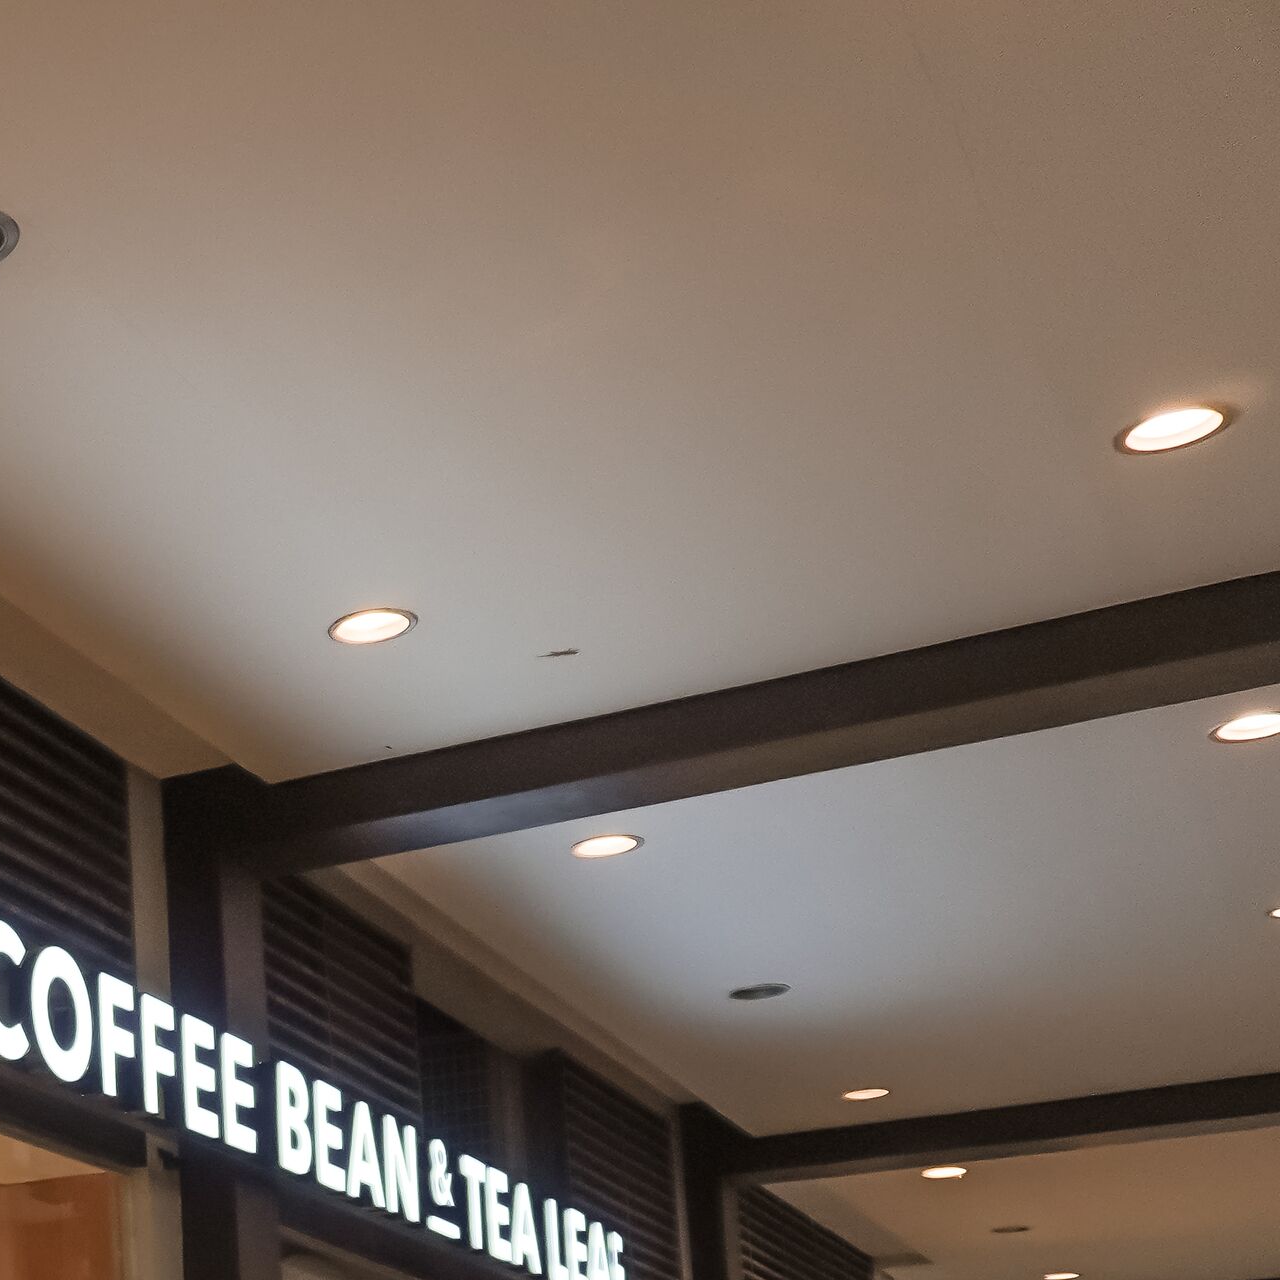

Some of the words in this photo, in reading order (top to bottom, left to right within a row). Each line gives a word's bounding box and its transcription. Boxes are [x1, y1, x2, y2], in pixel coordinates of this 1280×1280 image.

[276, 1060, 421, 1223] BEAN
[428, 1138, 456, 1207] &
[458, 1154, 542, 1275] TEA
